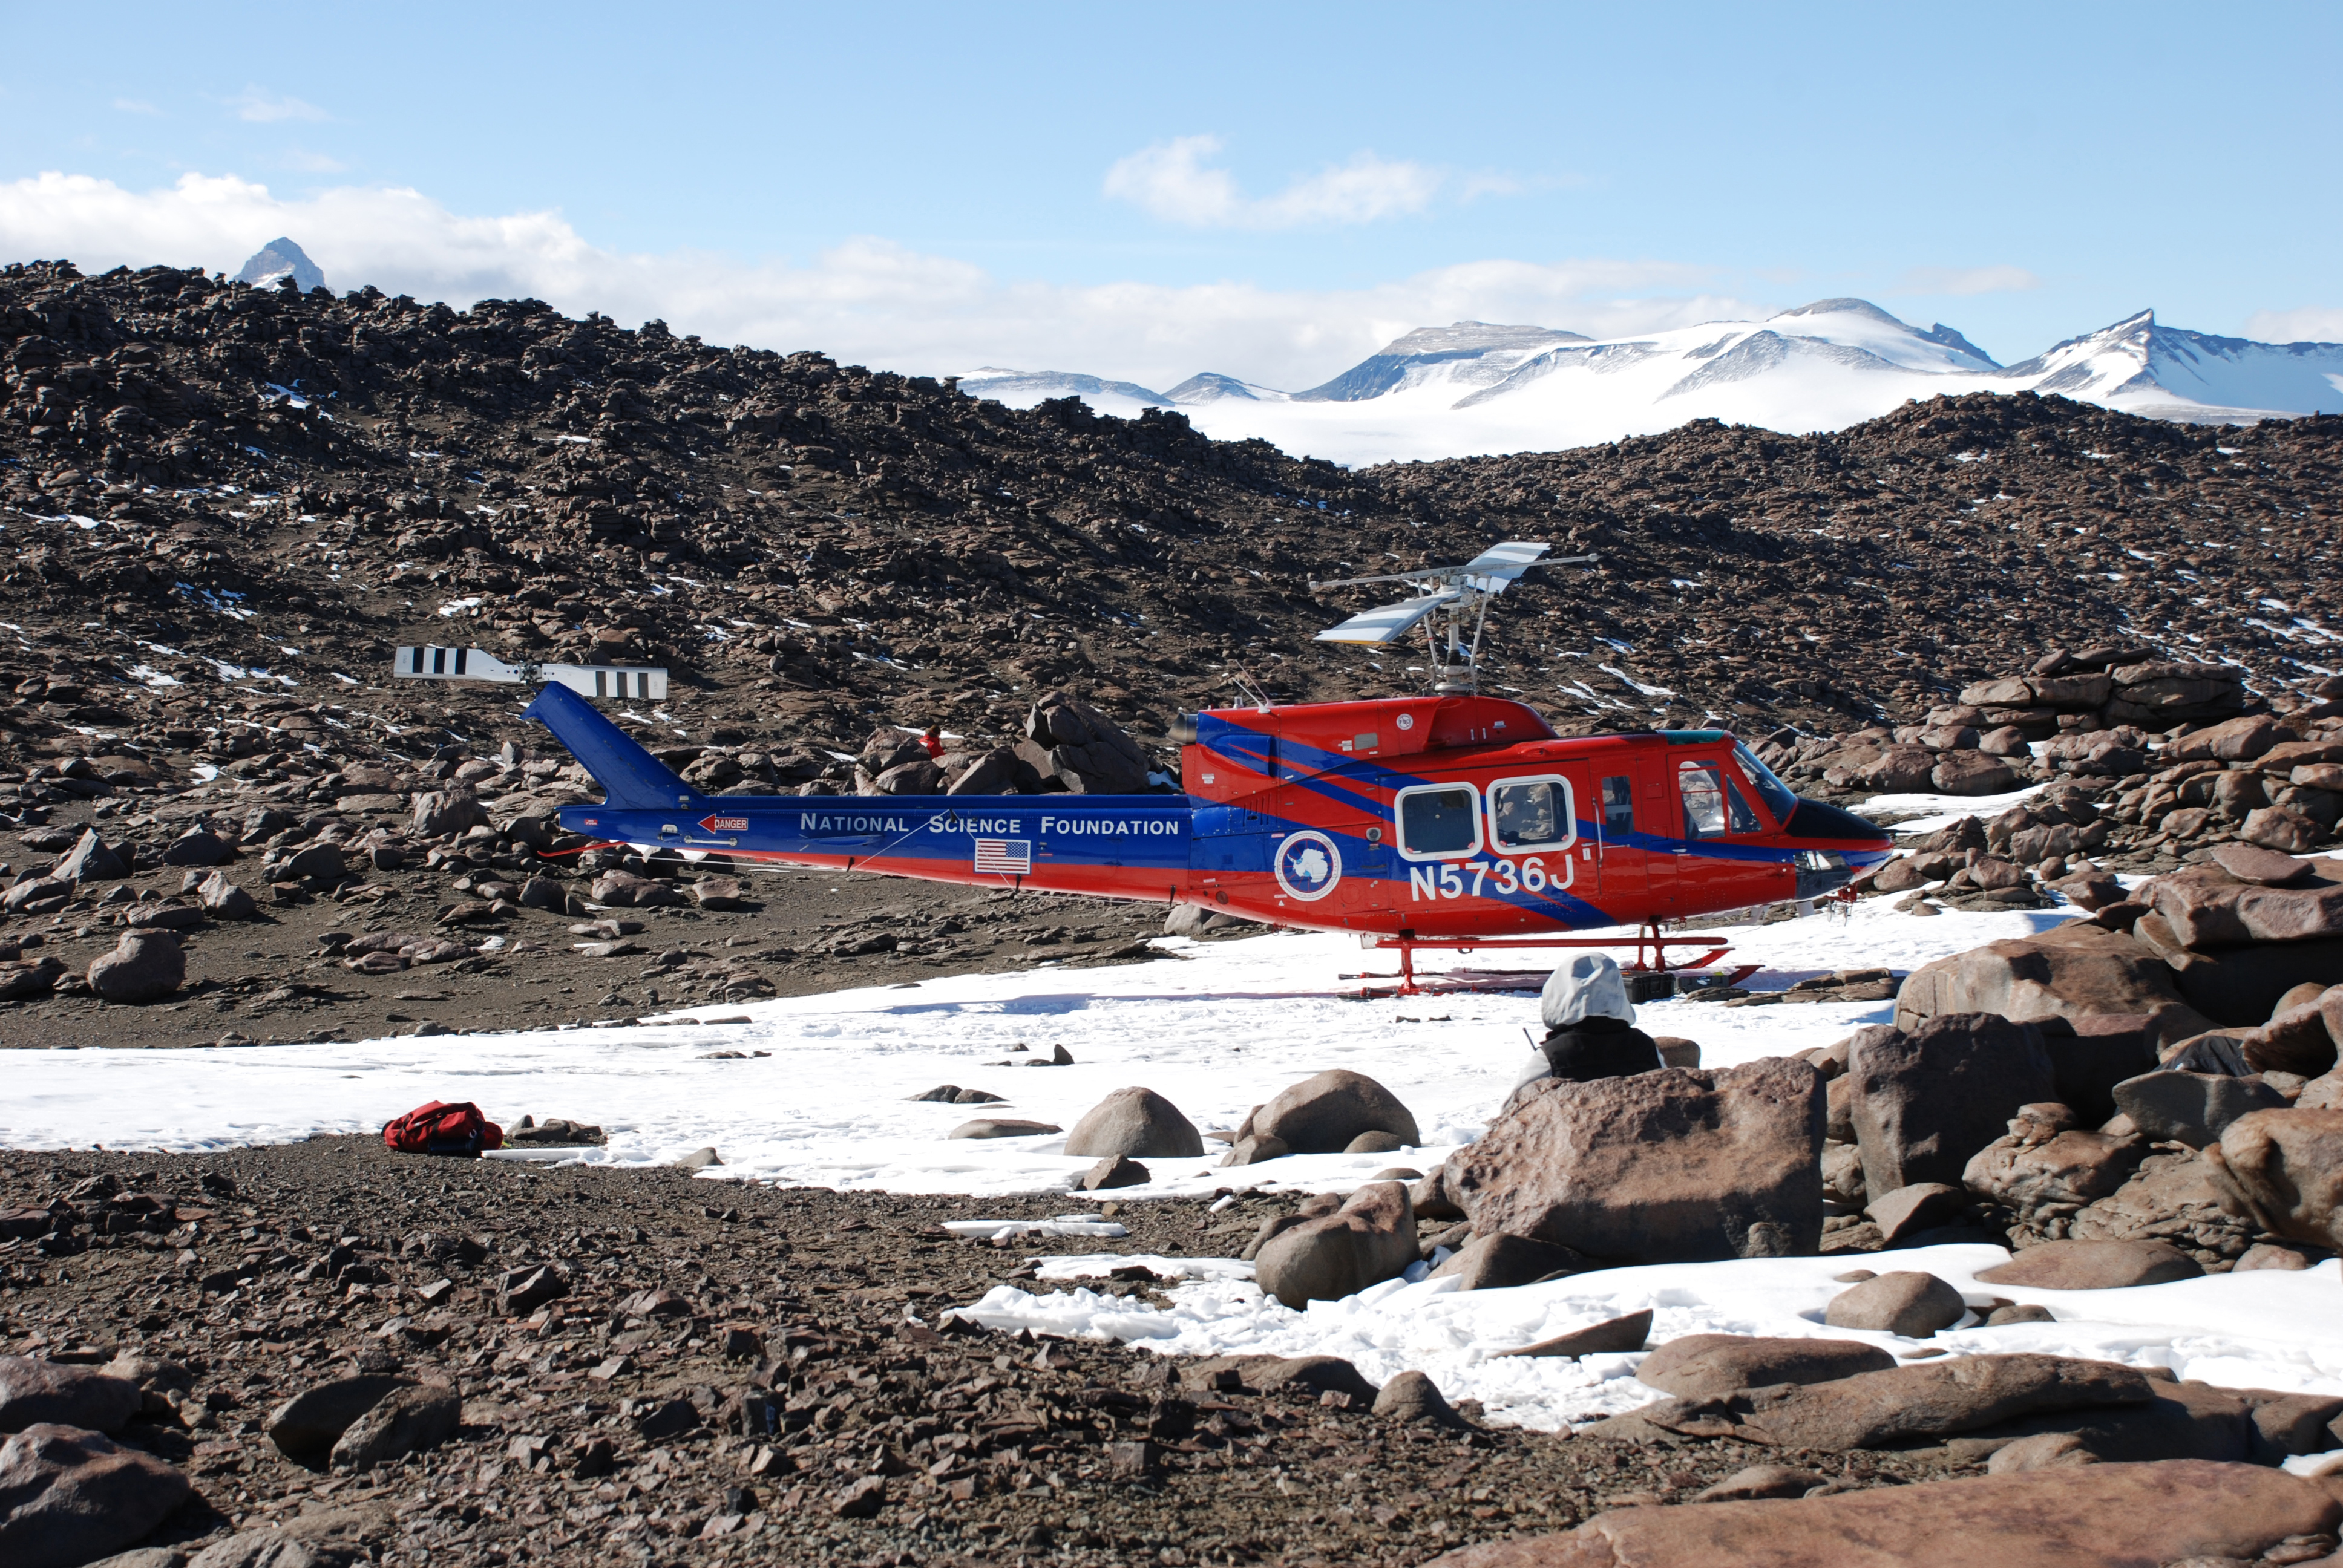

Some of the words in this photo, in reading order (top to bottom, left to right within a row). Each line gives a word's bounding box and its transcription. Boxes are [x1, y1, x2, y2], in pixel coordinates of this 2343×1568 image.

[715, 819, 747, 829] DANGER
[801, 813, 909, 832] NATIONAL
[929, 815, 1021, 834] SCIENCE
[1041, 816, 1178, 835] FOUNDATION
[1410, 854, 1575, 901] N5736J
